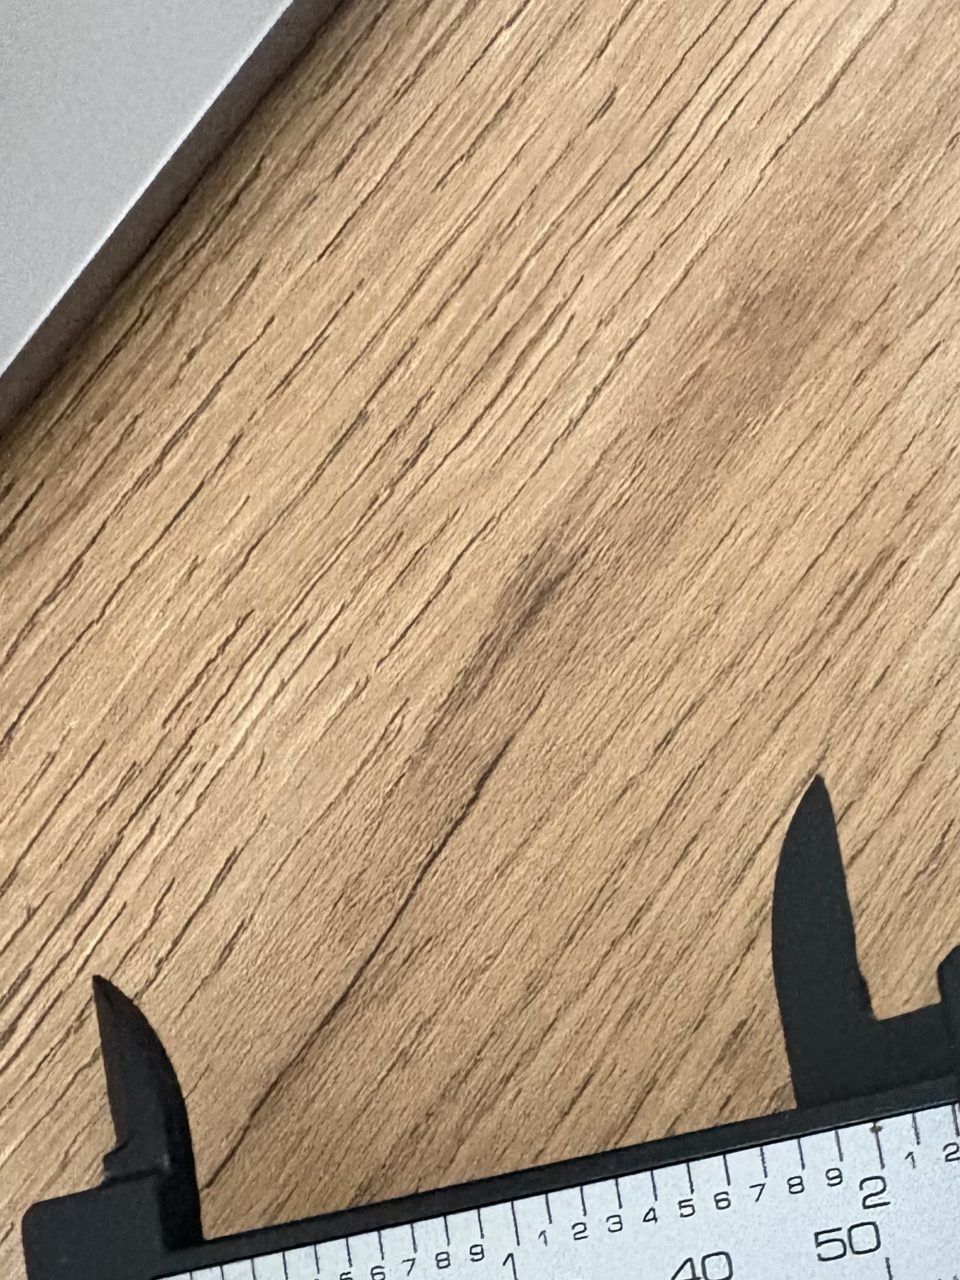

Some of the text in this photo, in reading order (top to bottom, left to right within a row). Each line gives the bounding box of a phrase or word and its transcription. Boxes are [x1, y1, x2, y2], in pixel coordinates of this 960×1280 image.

[401, 1259, 417, 1276] 7
[435, 1251, 451, 1270] 8
[469, 1244, 485, 1262] 9
[538, 1230, 548, 1247] 1
[571, 1222, 589, 1241] 2
[606, 1215, 623, 1234] 3
[642, 1207, 659, 1225] 4
[677, 1199, 696, 1218] 5
[713, 1191, 731, 1210] 6
[749, 1184, 767, 1202] 7
[787, 1176, 805, 1195] 8
[825, 1168, 844, 1187] 9
[858, 1175, 891, 1210] 2
[904, 1151, 917, 1169] 1
[813, 1221, 882, 1262] 50
